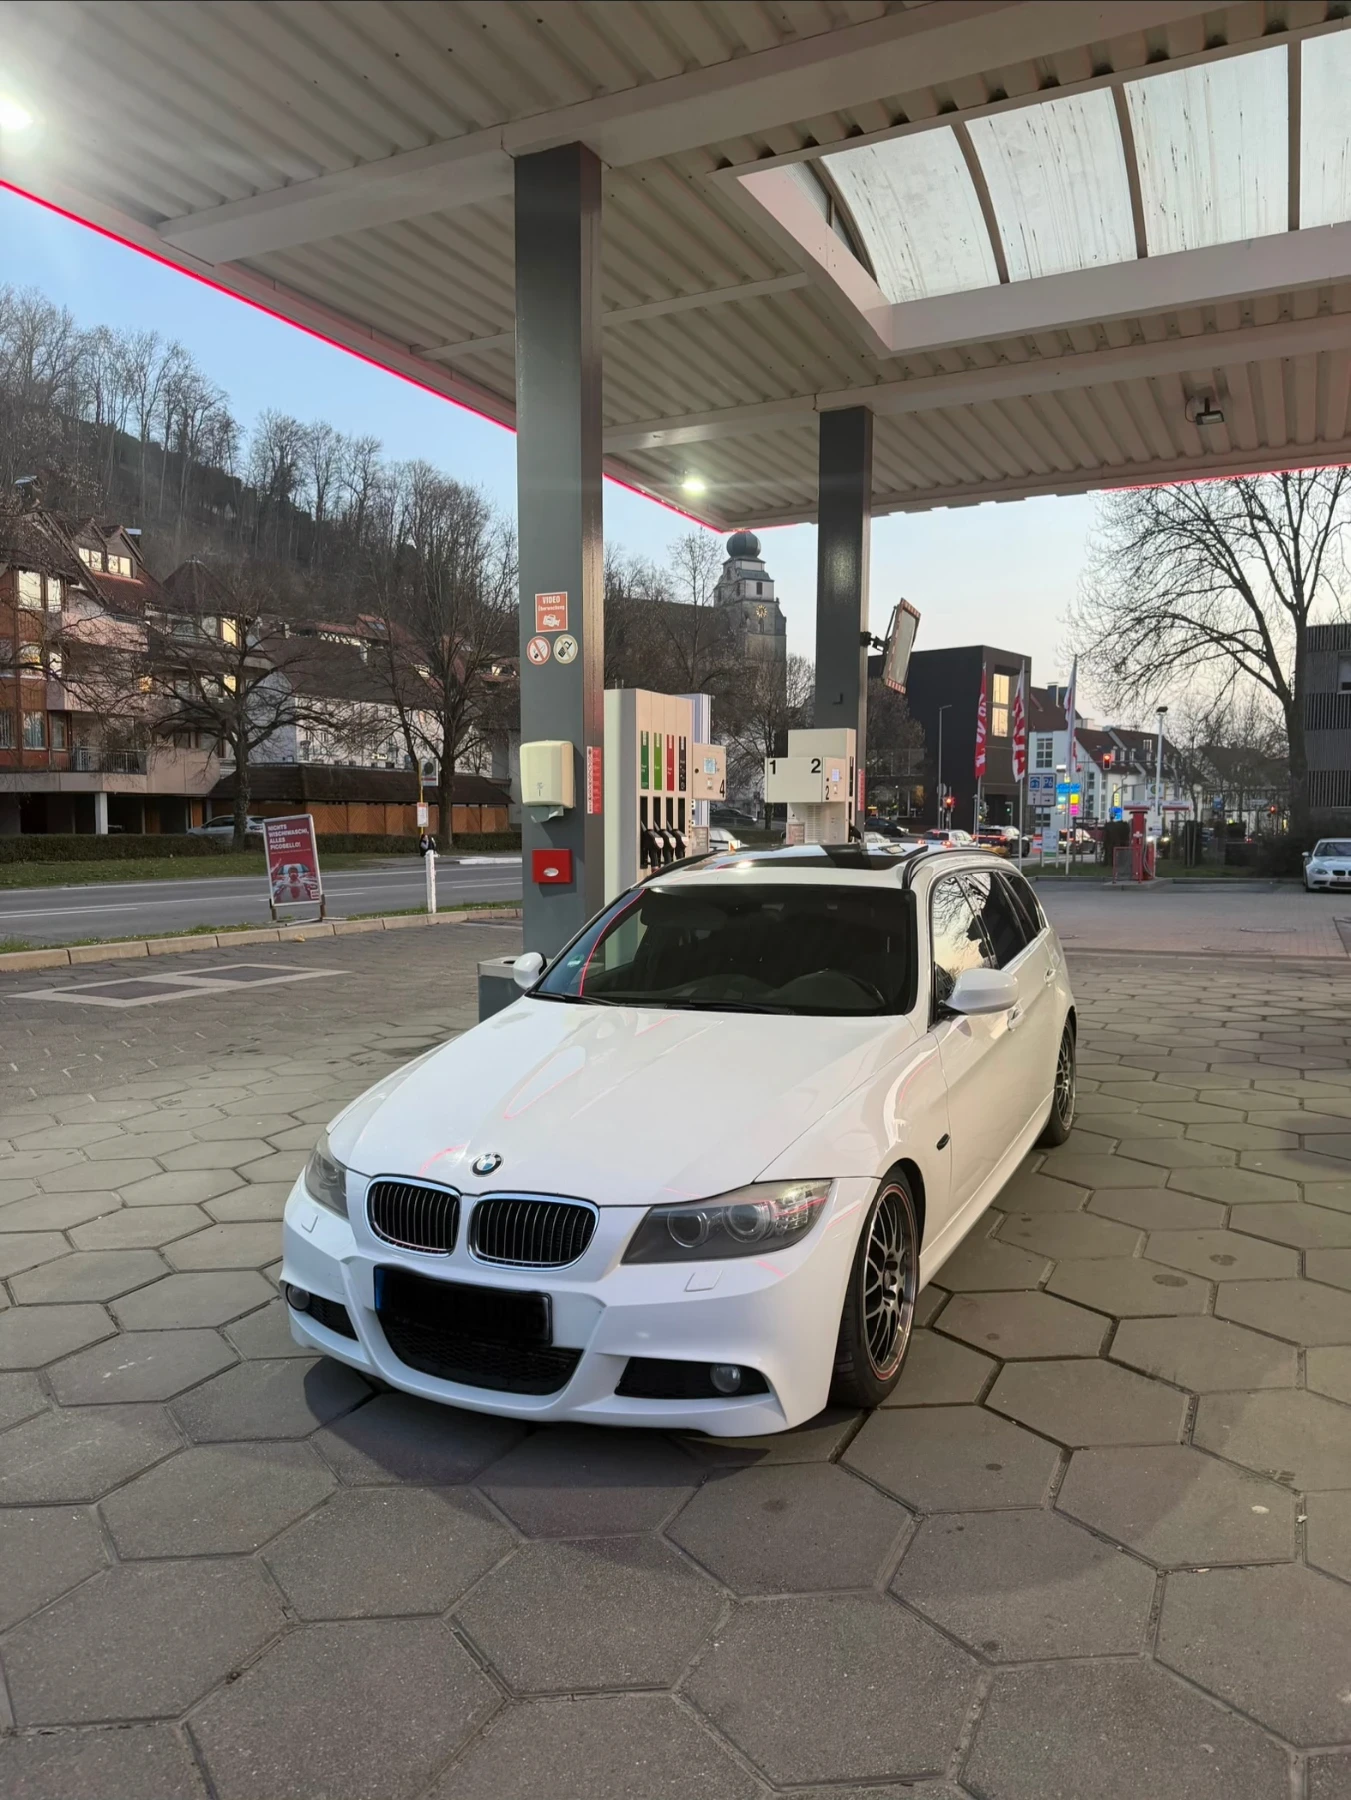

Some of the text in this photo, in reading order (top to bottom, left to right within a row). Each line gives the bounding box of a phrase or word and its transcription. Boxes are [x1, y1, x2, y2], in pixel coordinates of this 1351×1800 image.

[542, 596, 560, 604] VIDEO
[769, 760, 776, 775] 1
[811, 758, 821, 773] 2
[720, 779, 725, 798] 4
[826, 785, 830, 800] 2
